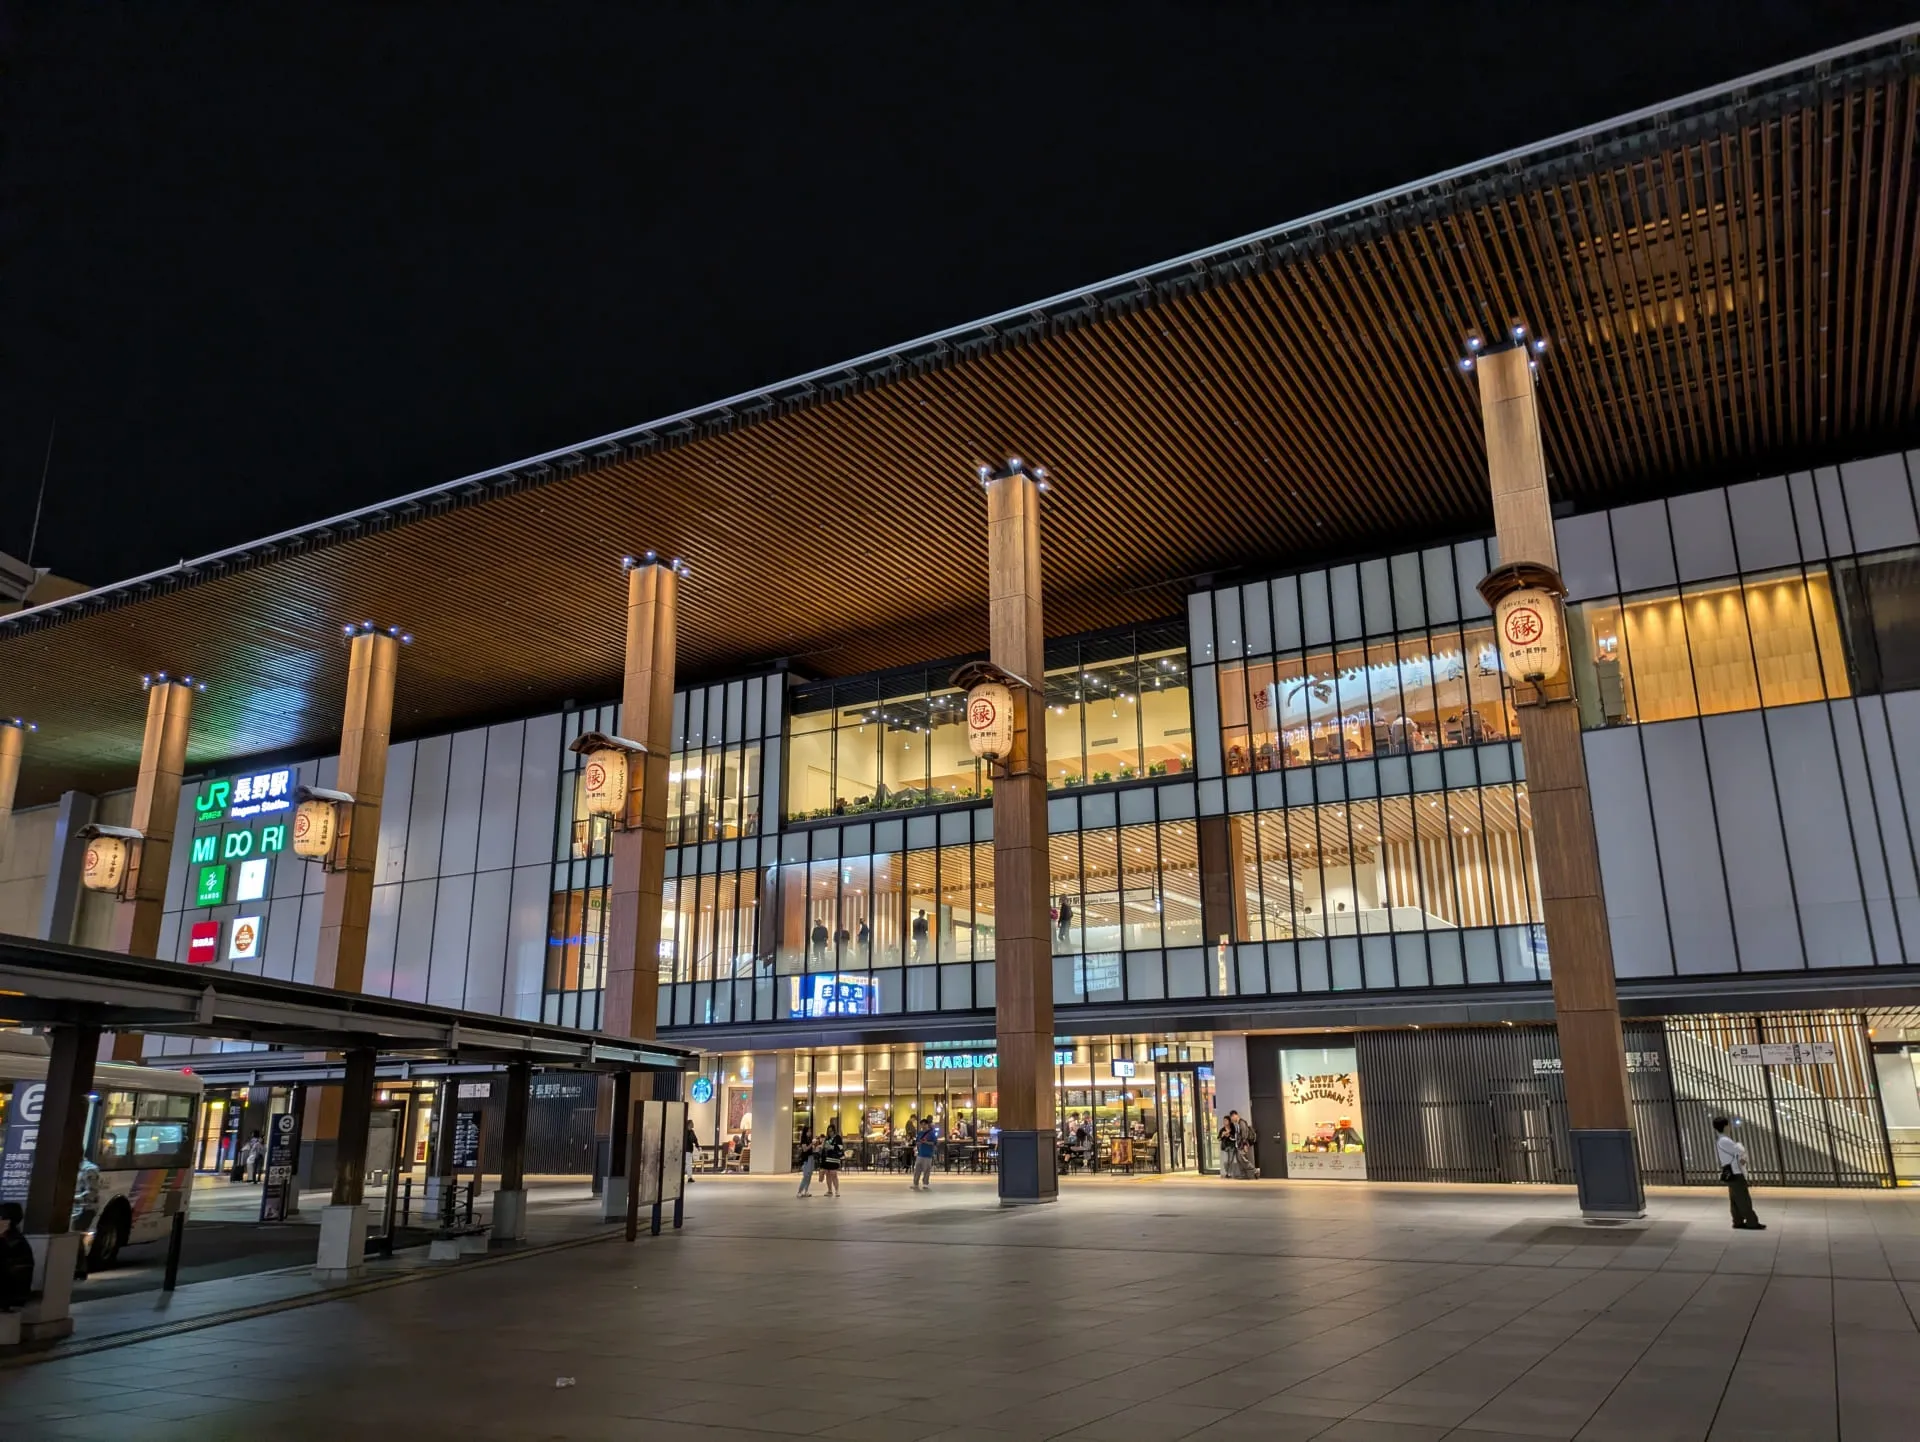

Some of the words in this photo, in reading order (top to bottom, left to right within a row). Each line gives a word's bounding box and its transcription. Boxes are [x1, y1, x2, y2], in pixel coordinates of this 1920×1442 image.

[1511, 614, 1538, 640] 縁
[972, 704, 991, 724] 縁
[197, 781, 230, 811] JR
[234, 771, 288, 803] 長野駅
[231, 805, 260, 817] Nagano
[262, 800, 289, 812] Station
[1533, 1059, 1561, 1068] 善光寺
[1309, 1075, 1334, 1084] LOVE
[1300, 1089, 1346, 1105] AUTUMN
